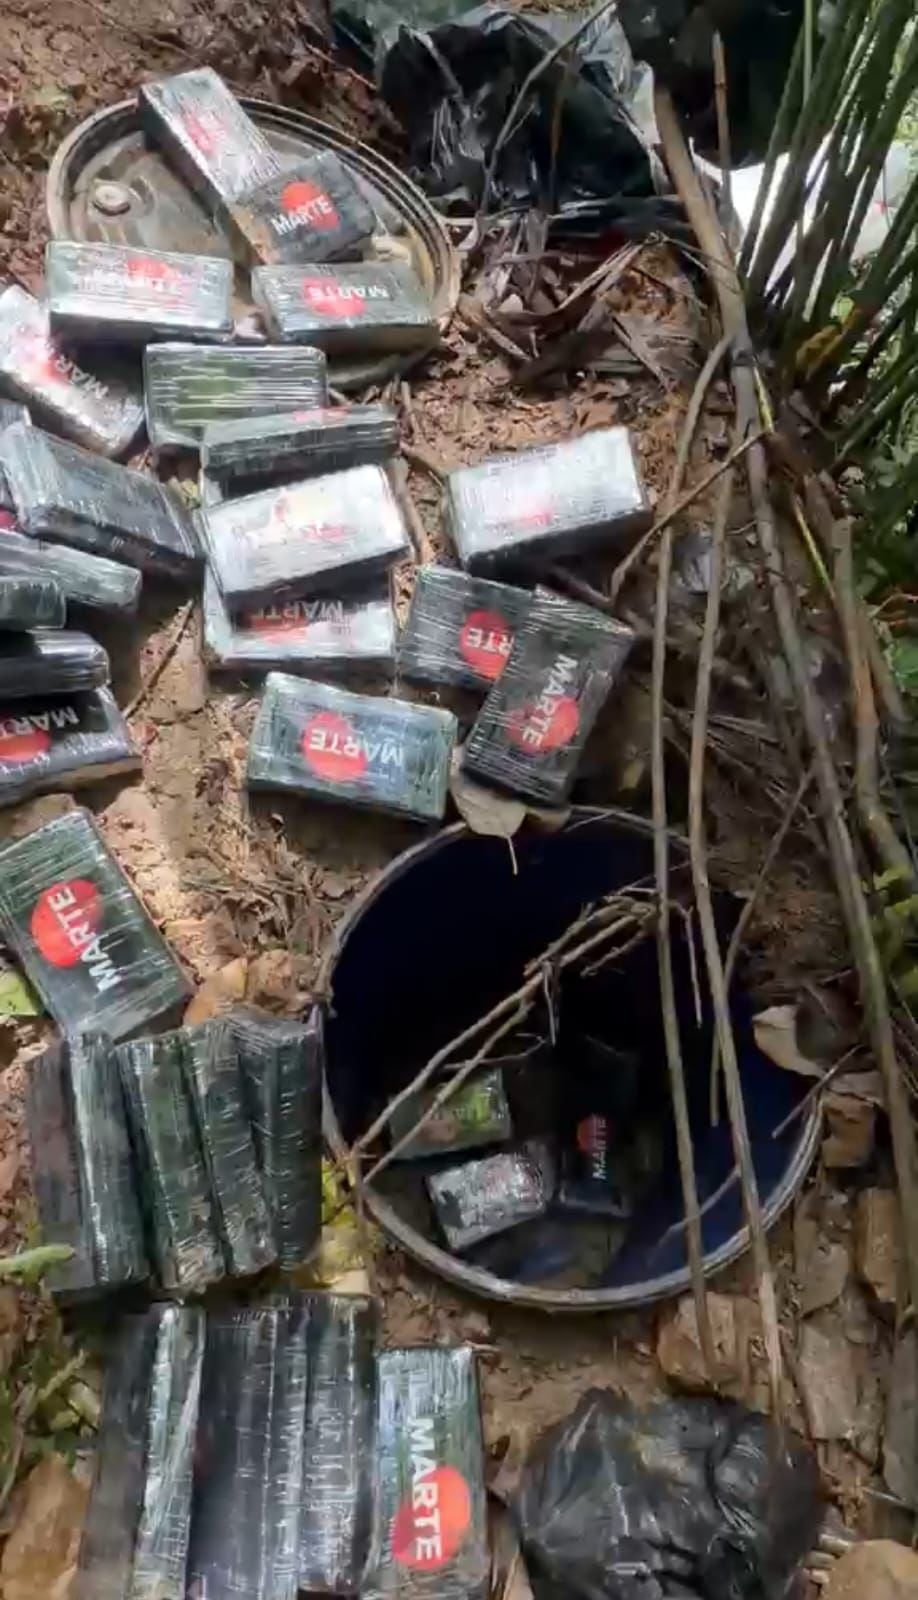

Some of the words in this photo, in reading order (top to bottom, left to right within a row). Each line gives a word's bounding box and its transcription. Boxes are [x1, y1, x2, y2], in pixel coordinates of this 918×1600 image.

[270, 196, 333, 235] MARTE
[466, 628, 514, 659] RTE
[522, 654, 578, 747] MARTE
[311, 729, 403, 764] MARTE
[48, 885, 122, 993] MARTE
[406, 1417, 442, 1561] MARTE
